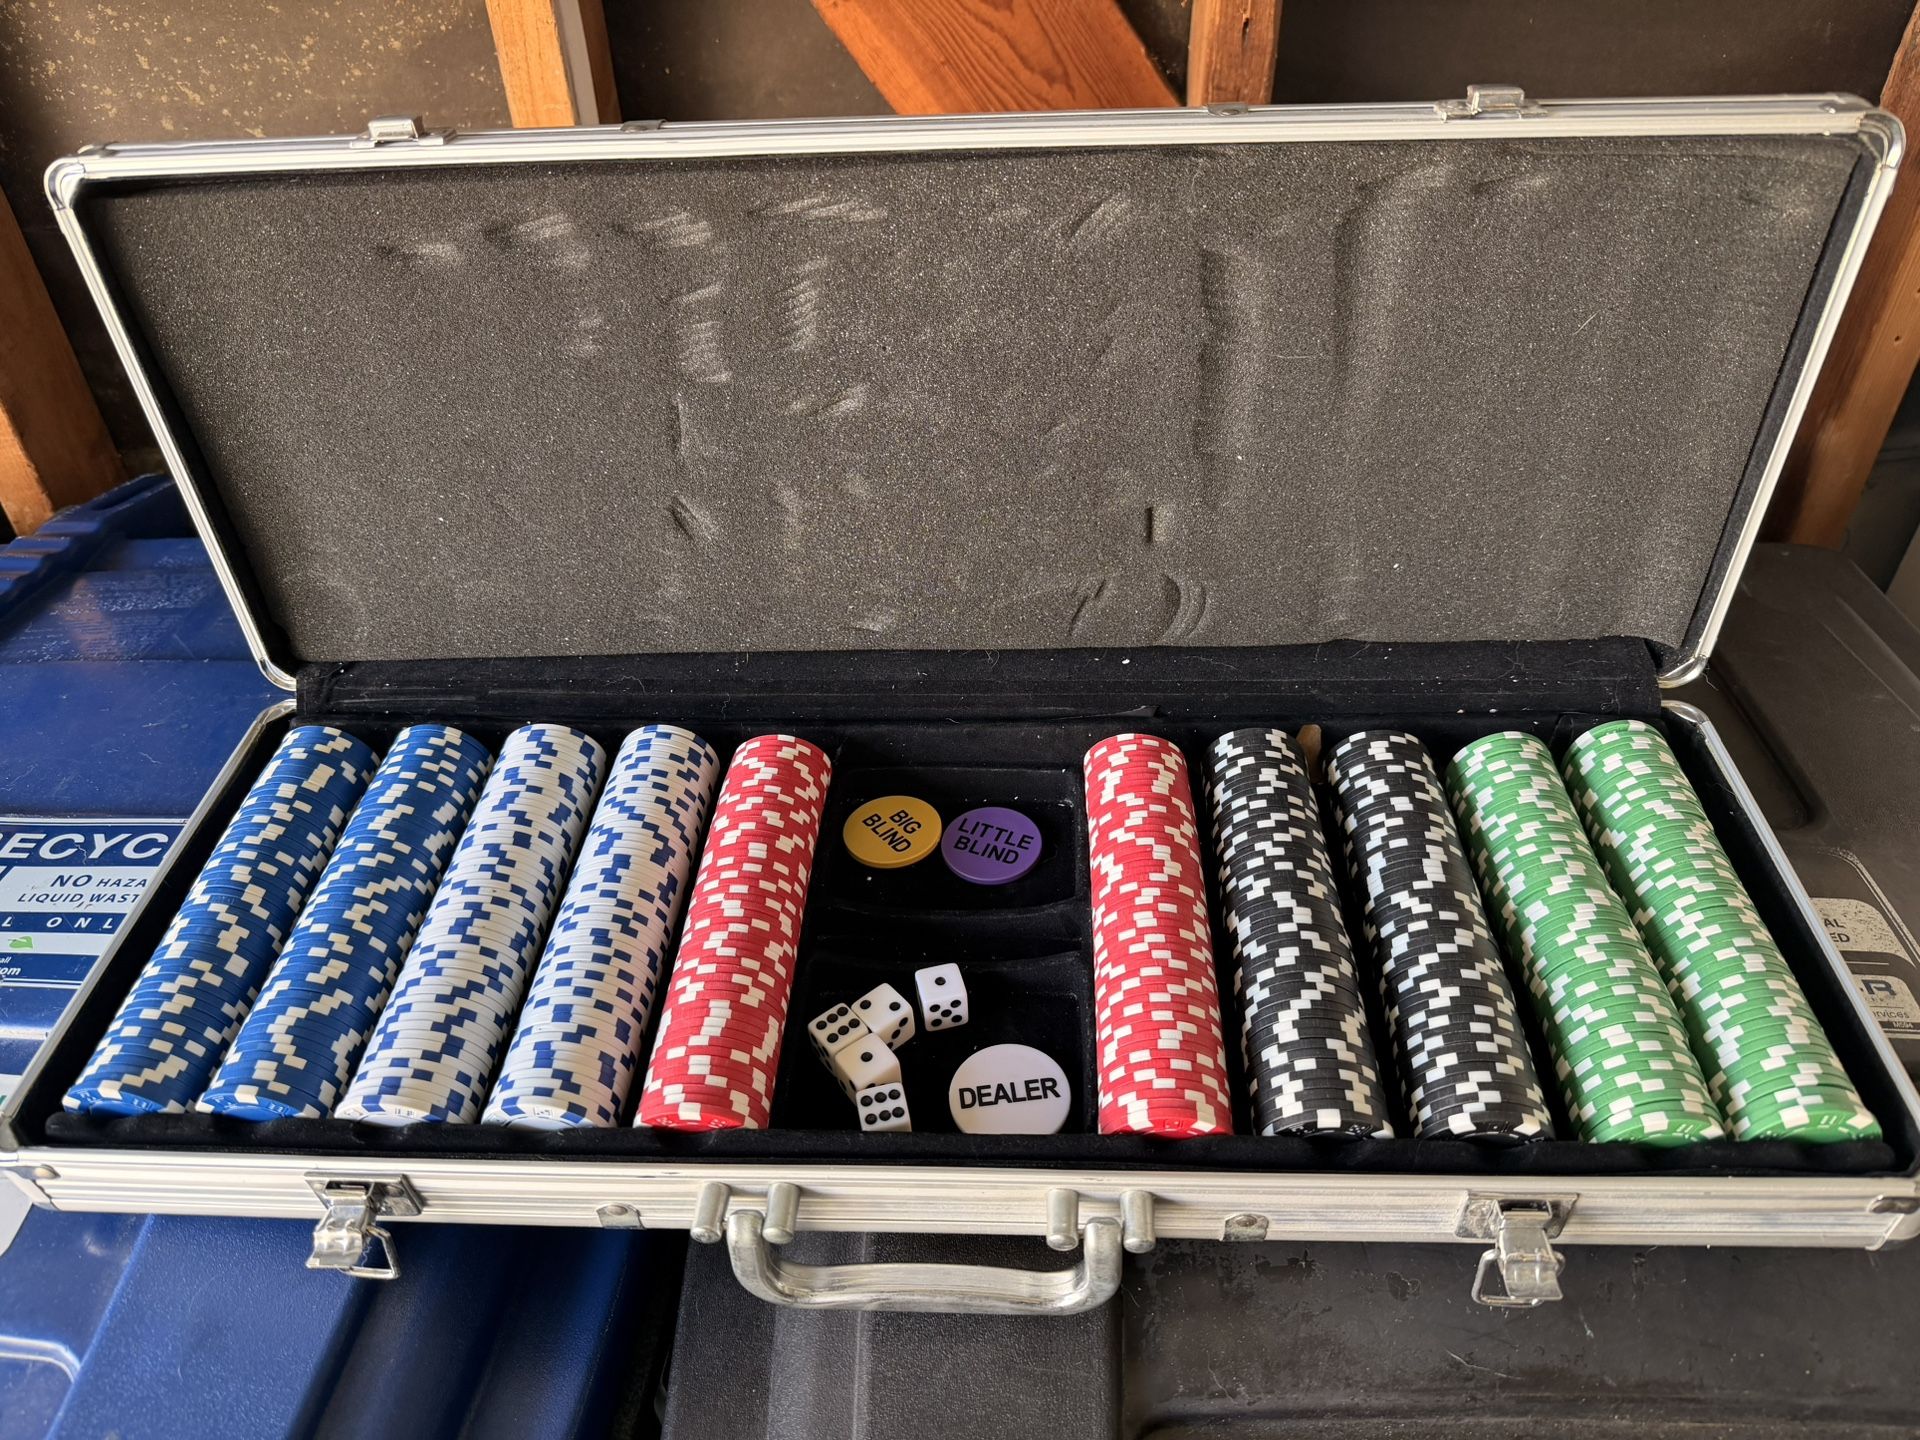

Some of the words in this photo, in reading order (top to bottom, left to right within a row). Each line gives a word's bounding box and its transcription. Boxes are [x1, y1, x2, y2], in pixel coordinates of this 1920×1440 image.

[862, 813, 912, 853] BLIND
[889, 809, 922, 835] BIG
[958, 818, 1034, 850] LITTLE
[0, 832, 169, 860] ECYC
[954, 835, 1019, 865] BLIND
[51, 875, 92, 887] NO
[96, 878, 148, 888] HAZA
[18, 894, 83, 902] LIQUID
[89, 893, 140, 904] WAST
[0, 967, 21, 976] om
[958, 1077, 1061, 1109] DEALER
